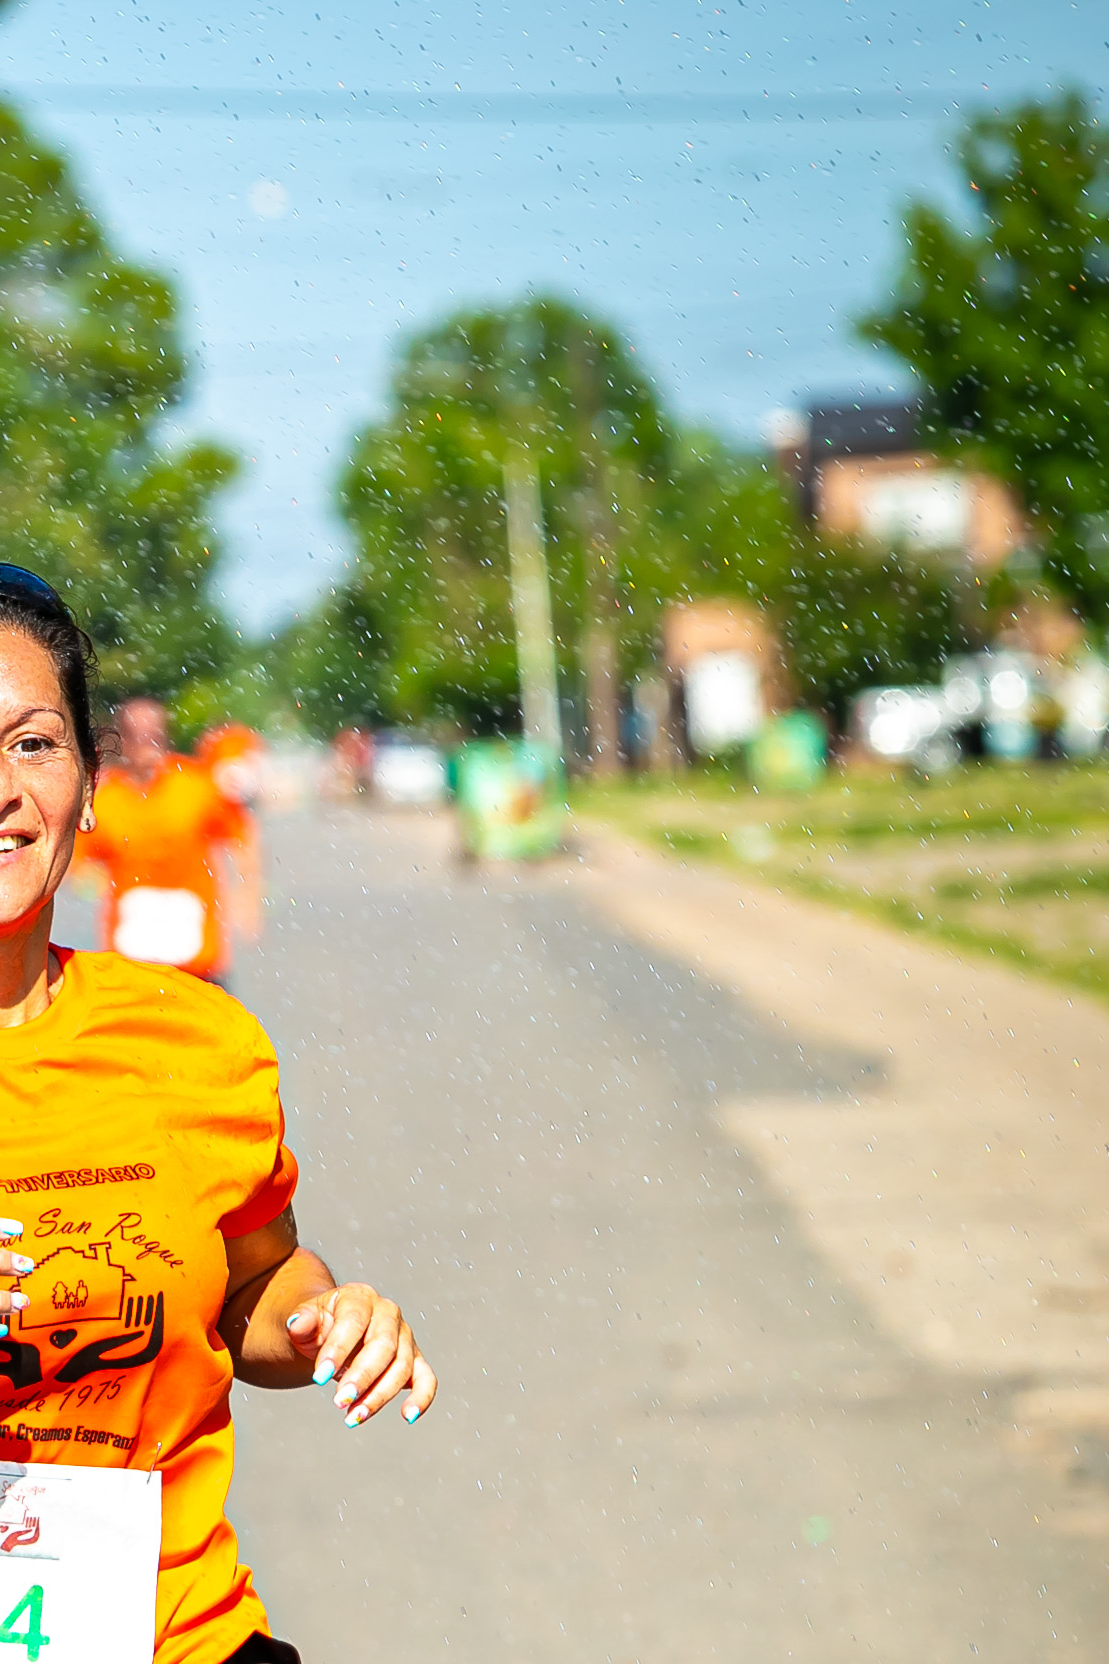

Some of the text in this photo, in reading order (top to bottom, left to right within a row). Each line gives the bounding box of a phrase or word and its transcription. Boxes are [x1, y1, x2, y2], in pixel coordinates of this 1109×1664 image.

[34, 1208, 184, 1269] San Roque
[58, 1375, 127, 1411] 1975
[16, 1423, 72, 1442] Creamos
